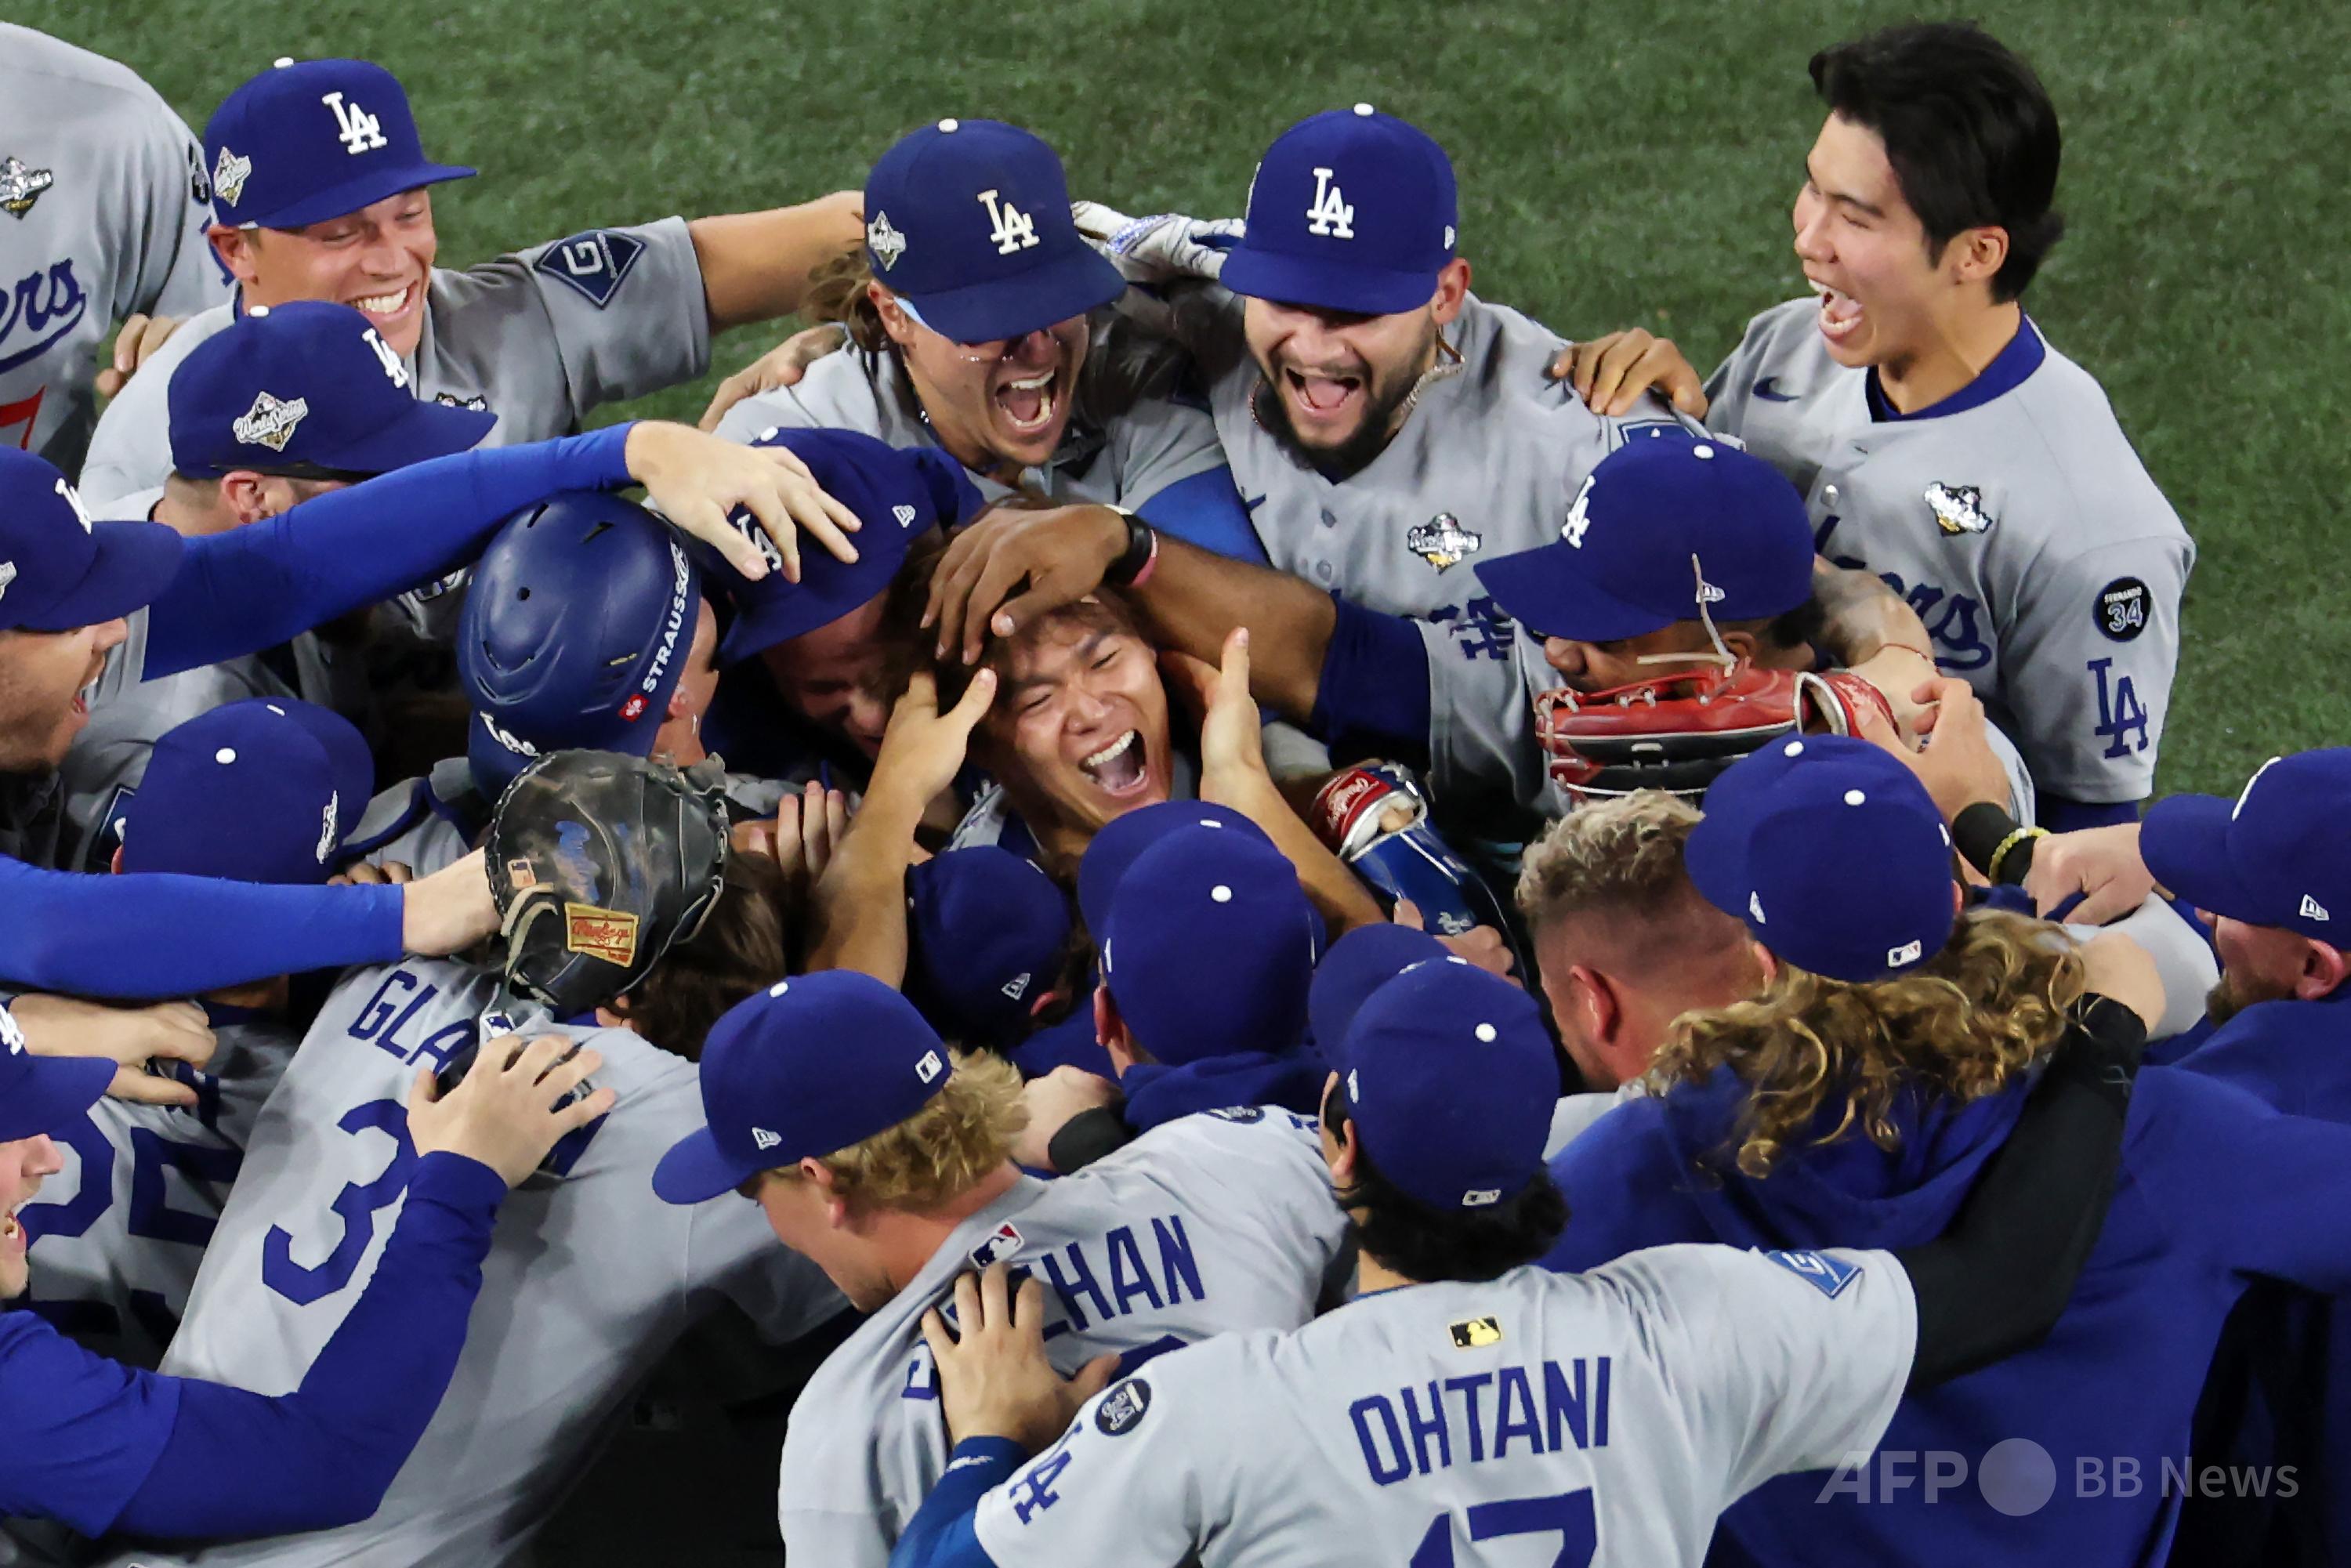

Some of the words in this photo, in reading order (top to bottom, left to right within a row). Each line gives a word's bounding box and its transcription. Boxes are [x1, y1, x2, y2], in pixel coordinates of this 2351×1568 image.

[322, 91, 388, 154] LA
[977, 189, 1040, 255] LA
[1306, 167, 1354, 239] LA
[643, 581, 688, 693] STRAUSS
[2107, 597, 2143, 632] 34
[2087, 657, 2150, 759] LA
[1349, 1356, 1611, 1486] OHTANI
